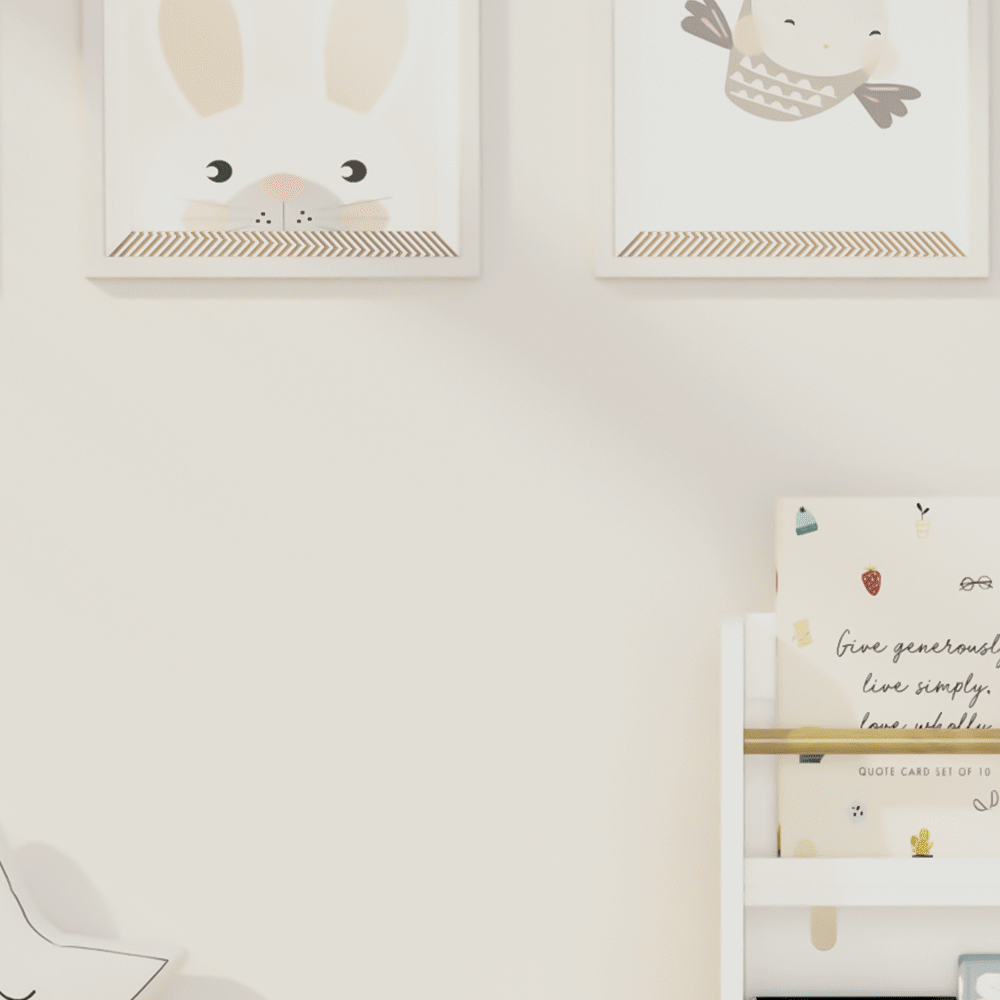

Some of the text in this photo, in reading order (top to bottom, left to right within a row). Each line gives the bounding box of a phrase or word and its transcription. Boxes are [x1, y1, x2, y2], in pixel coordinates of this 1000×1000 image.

[836, 629, 887, 657] Give
[862, 672, 909, 694] live
[858, 766, 991, 777] QUOTE CARD SET OF 10
